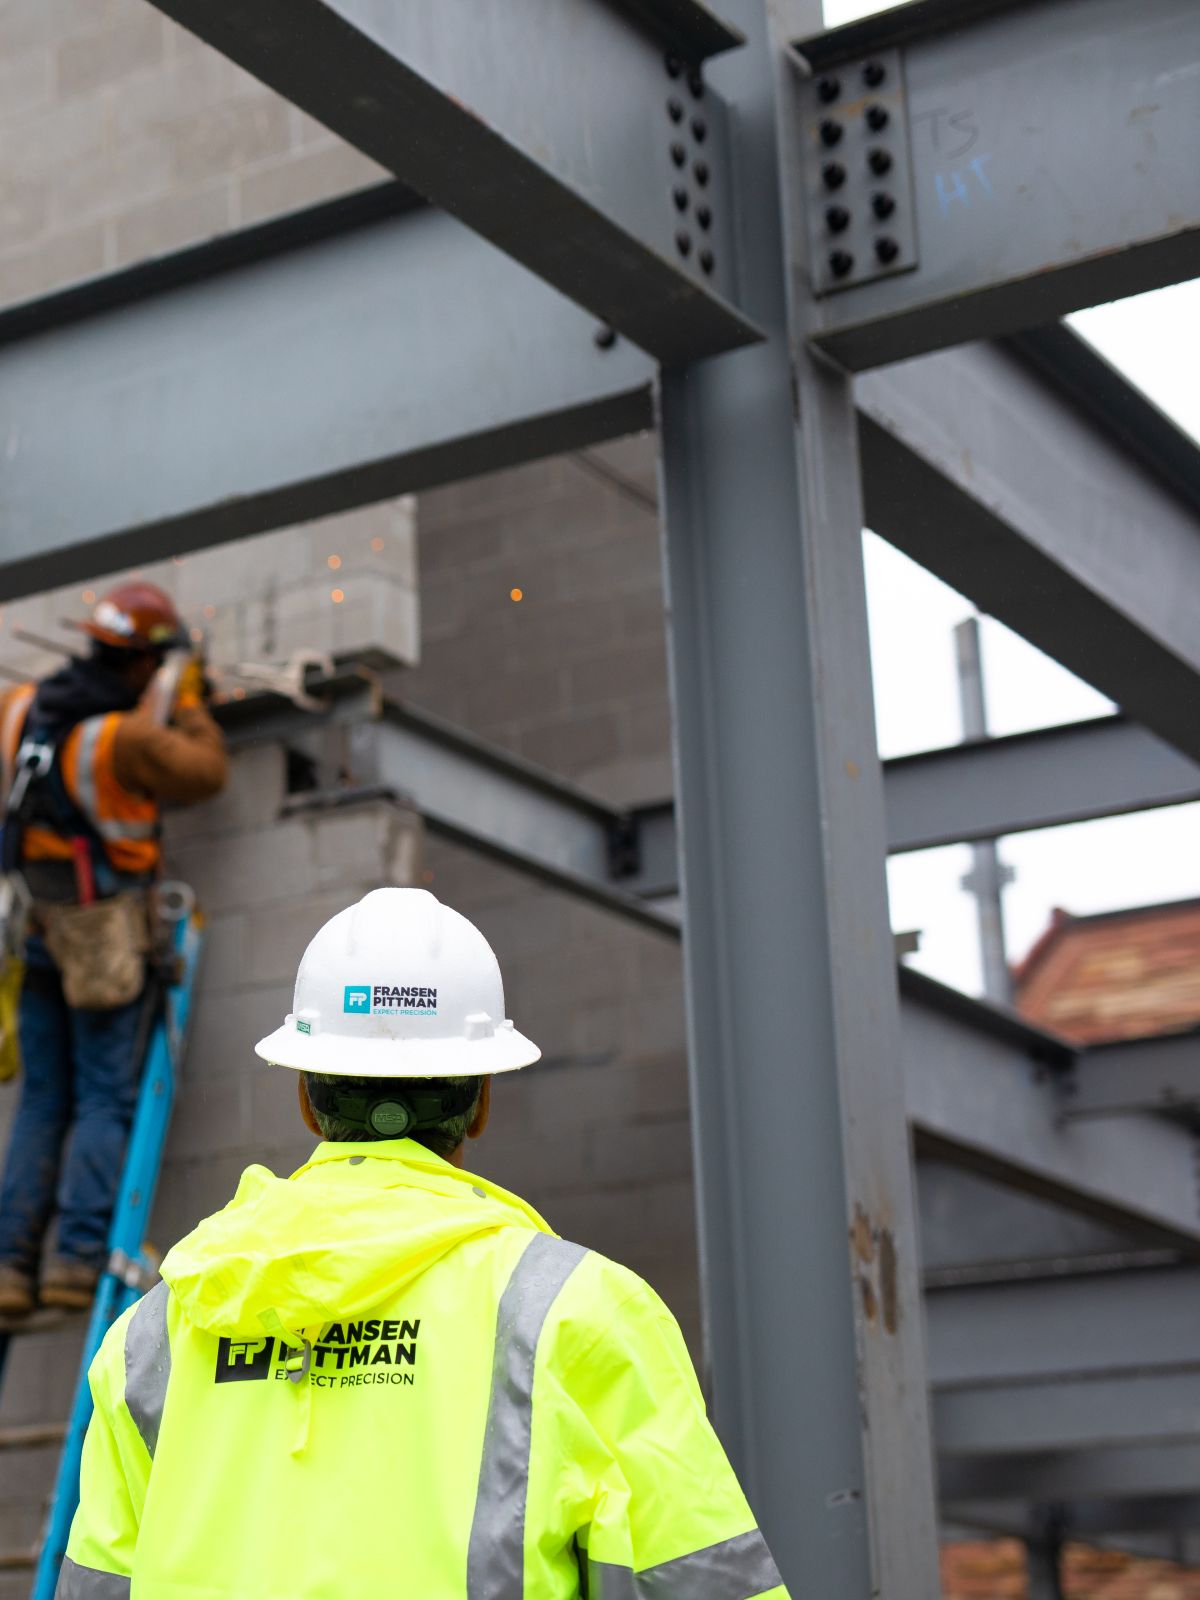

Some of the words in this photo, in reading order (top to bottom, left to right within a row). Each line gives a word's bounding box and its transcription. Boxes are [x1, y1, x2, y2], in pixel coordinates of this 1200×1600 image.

[911, 106, 979, 160] TS
[934, 153, 993, 216] HT
[373, 986, 437, 998] FRANSEN
[373, 997, 437, 1008] PITTMAN
[300, 1320, 420, 1344] ANSEN
[278, 1341, 416, 1369] TTMAN
[274, 1368, 337, 1388] EECT
[340, 1373, 414, 1388] PRECISION
